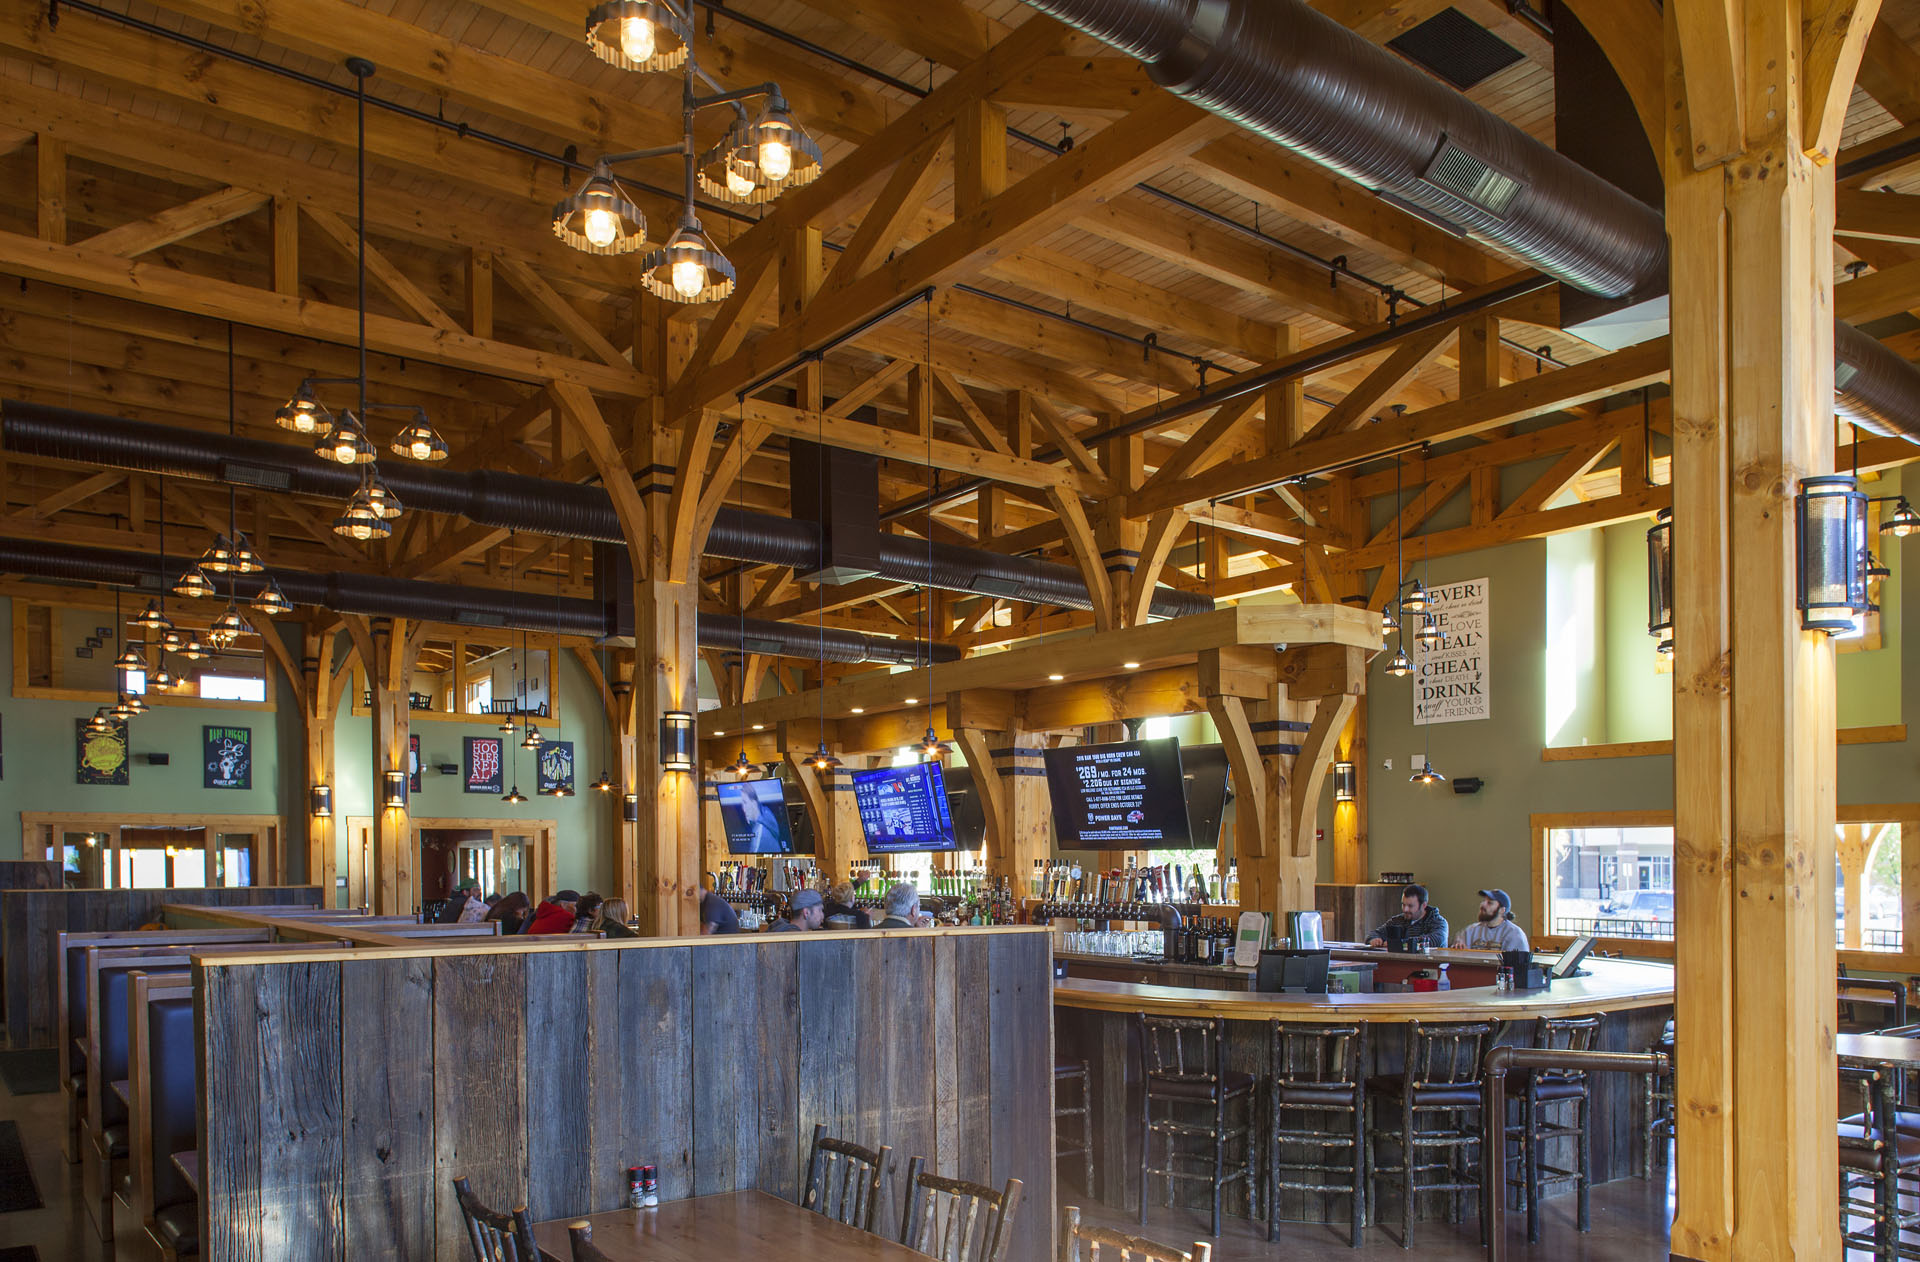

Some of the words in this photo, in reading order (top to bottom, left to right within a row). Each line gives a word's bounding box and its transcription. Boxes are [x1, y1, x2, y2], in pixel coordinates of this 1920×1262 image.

[1450, 618, 1482, 632] LOVE
[1421, 633, 1476, 653] STEAL
[1445, 650, 1467, 658] KISSES
[1422, 657, 1481, 677] CHEAT
[1445, 674, 1469, 682] DEATH
[1422, 681, 1482, 700] DRINK
[1445, 697, 1472, 707] YOUR
[1444, 706, 1484, 717] FRIENDS
[472, 743, 499, 753] HOO
[472, 752, 498, 762] SIER
[473, 760, 498, 770] RED
[1122, 766, 1132, 776] 24
[1133, 768, 1147, 776] MOS.
[1120, 778, 1142, 786] SIGNING
